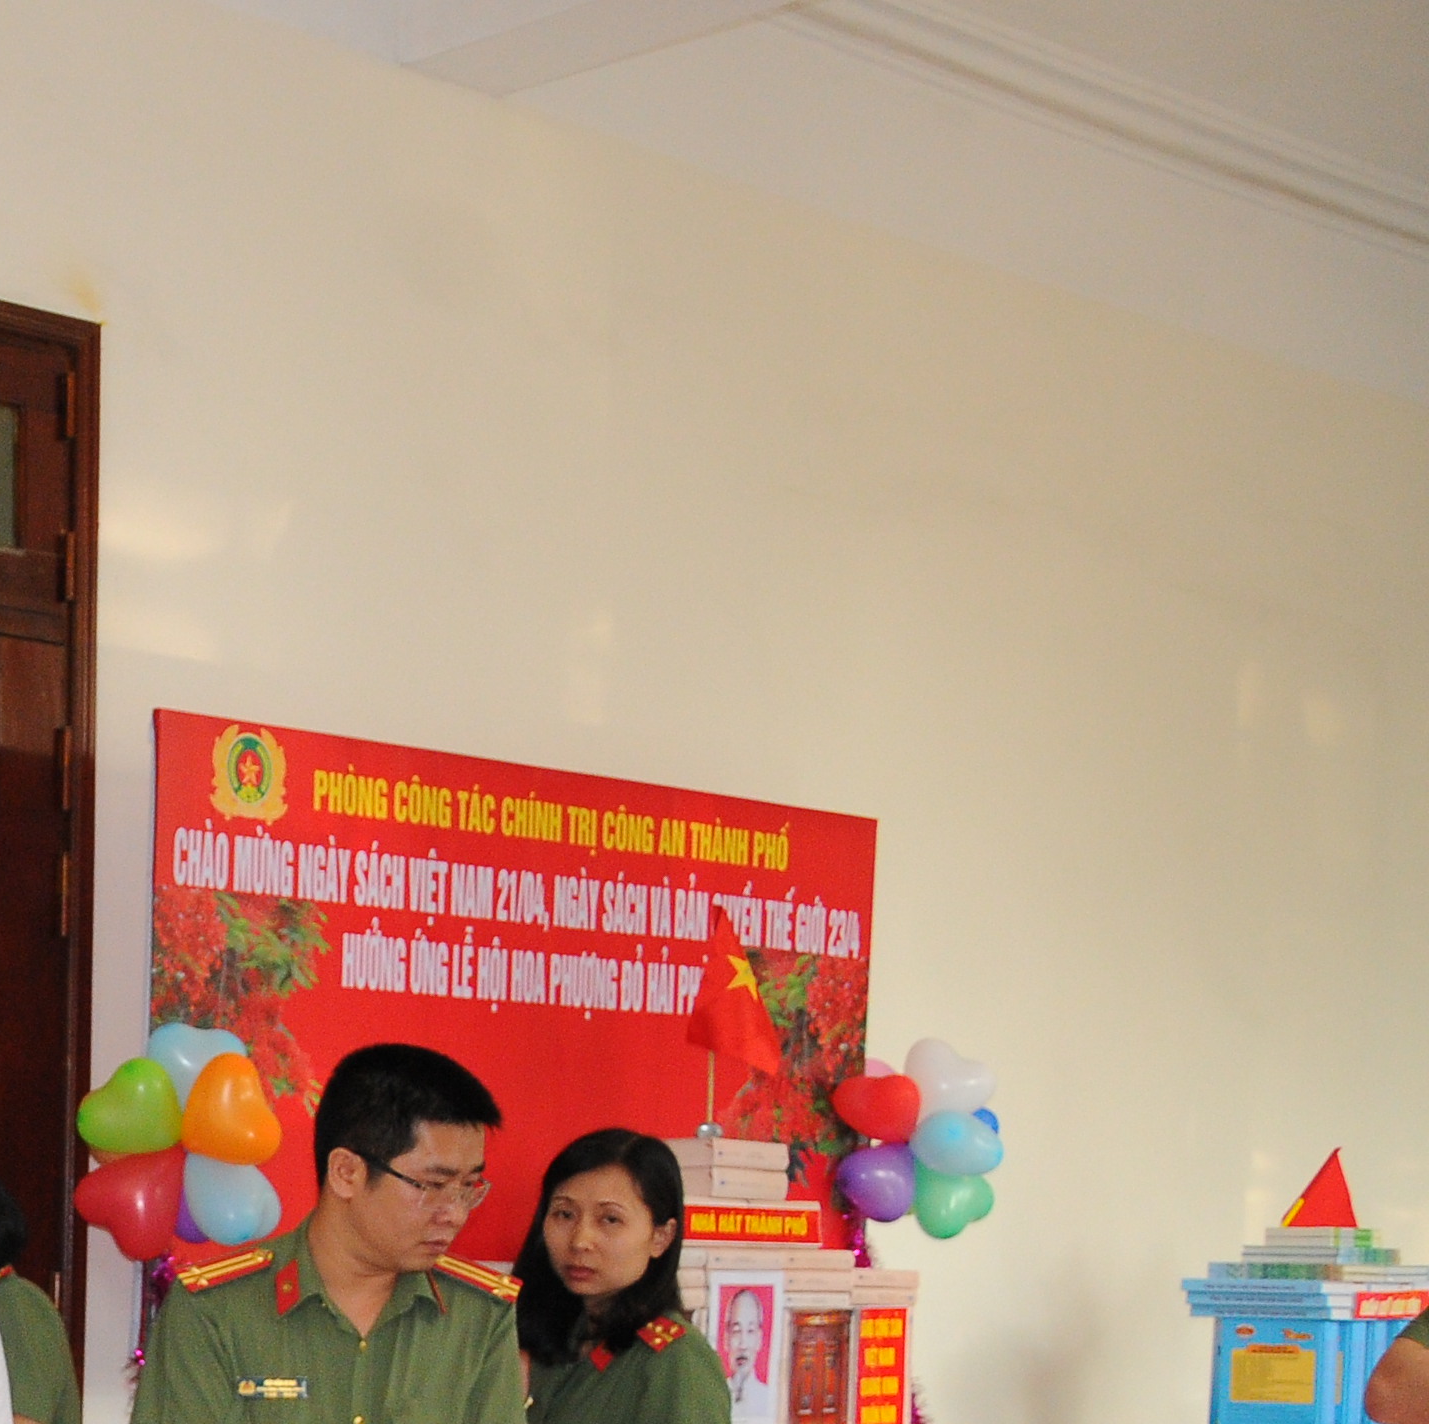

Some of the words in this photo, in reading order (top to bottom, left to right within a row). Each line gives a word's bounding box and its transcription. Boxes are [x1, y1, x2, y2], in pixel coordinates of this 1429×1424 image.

[313, 763, 389, 820] PHÒNG
[393, 774, 452, 828] CÔNG
[457, 784, 496, 834] TÁC
[501, 791, 562, 842] CHÍNH
[567, 806, 597, 856] TRỊ
[602, 805, 655, 854] CÔNG
[659, 819, 686, 858] AN
[690, 817, 749, 865] THÀNH
[753, 822, 790, 872] PHỐ
[173, 819, 230, 890] CHÀO
[233, 825, 294, 897] MỪNG
[297, 835, 351, 905] NGÀY
[354, 840, 406, 910] SÁCH
[409, 848, 448, 927] VIỆT
[450, 863, 494, 919] NAM
[553, 867, 601, 931] NGÀY
[602, 871, 648, 936] SÁCH
[651, 876, 672, 938] VÀ
[674, 872, 709, 942] BẢN
[765, 886, 795, 951] THẾ
[795, 896, 827, 954] GIỚI
[342, 916, 407, 993] HƯỞNG
[410, 927, 449, 997] ỨNG
[452, 926, 474, 999] LỄ
[477, 936, 508, 1013] HỘI
[511, 949, 546, 1005] HOA
[549, 950, 618, 1020] PHƯỢNG
[620, 943, 644, 1012] ĐỎ
[647, 945, 675, 1014] HẢI
